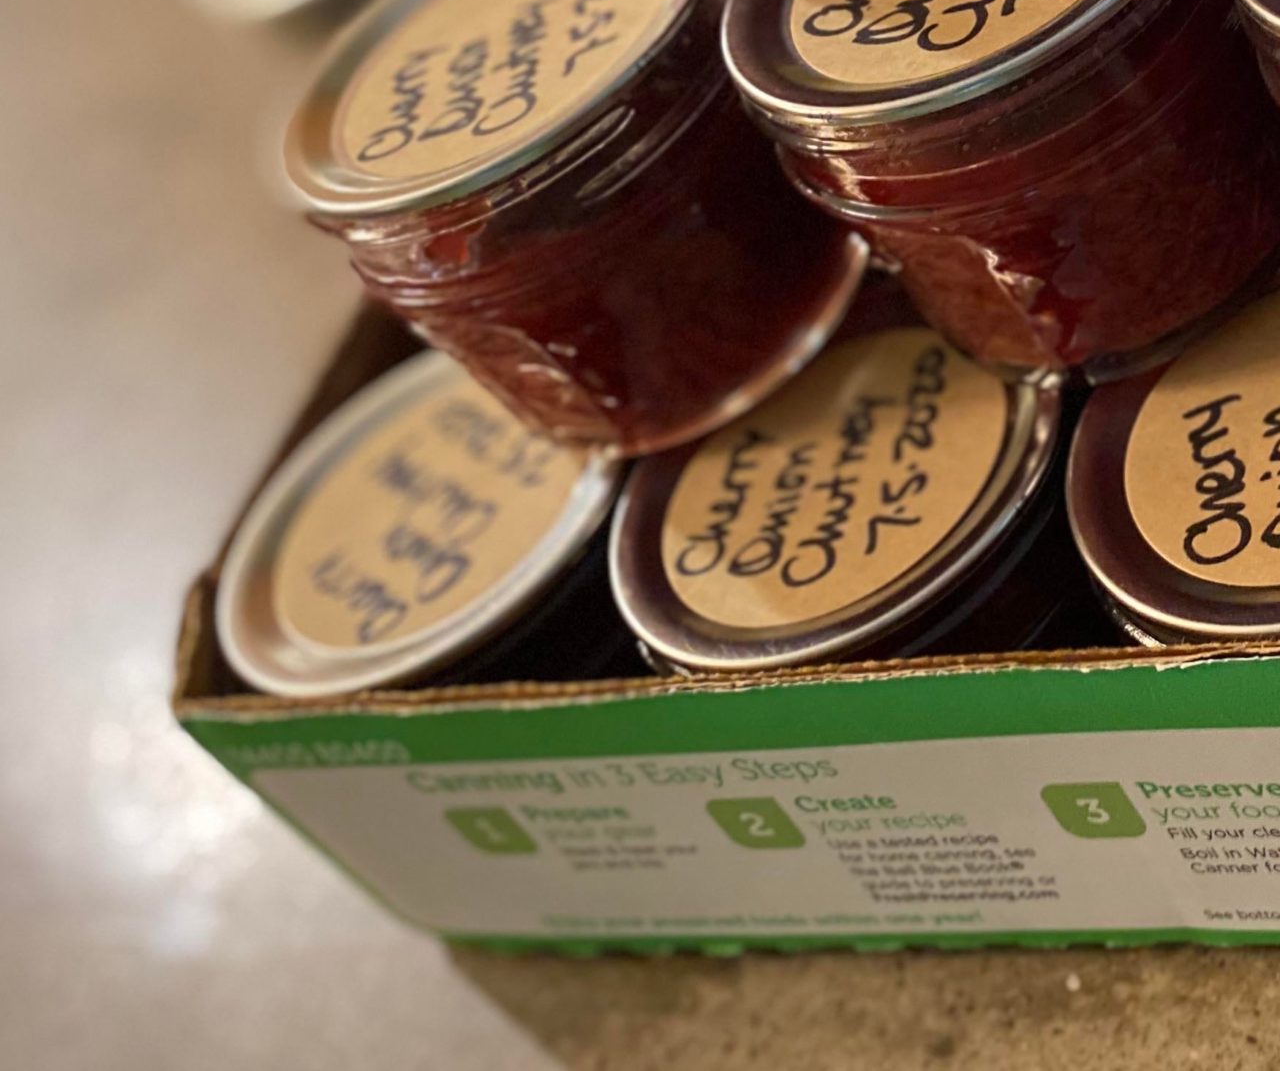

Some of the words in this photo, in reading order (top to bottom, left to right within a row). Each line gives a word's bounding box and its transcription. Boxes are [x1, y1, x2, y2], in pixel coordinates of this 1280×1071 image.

[780, 395, 899, 587] Chutney
[1183, 394, 1252, 565] Cherry
[676, 430, 777, 576] Cherry
[405, 768, 565, 795] Canning
[568, 767, 604, 789] in
[606, 763, 635, 787] 3
[637, 761, 724, 787] Easy
[731, 757, 839, 784] Steps
[794, 794, 896, 812] Create
[1076, 796, 1111, 824] 3
[738, 812, 776, 837] 2
[810, 815, 870, 834] your
[882, 811, 968, 830] recipe
[1150, 804, 1221, 826] your
[1166, 826, 1199, 840] Fill
[1205, 827, 1246, 841] your
[1179, 846, 1219, 860] Boil
[1223, 847, 1243, 859] in
[1190, 861, 1259, 874] Canner
[1203, 908, 1234, 921] See
